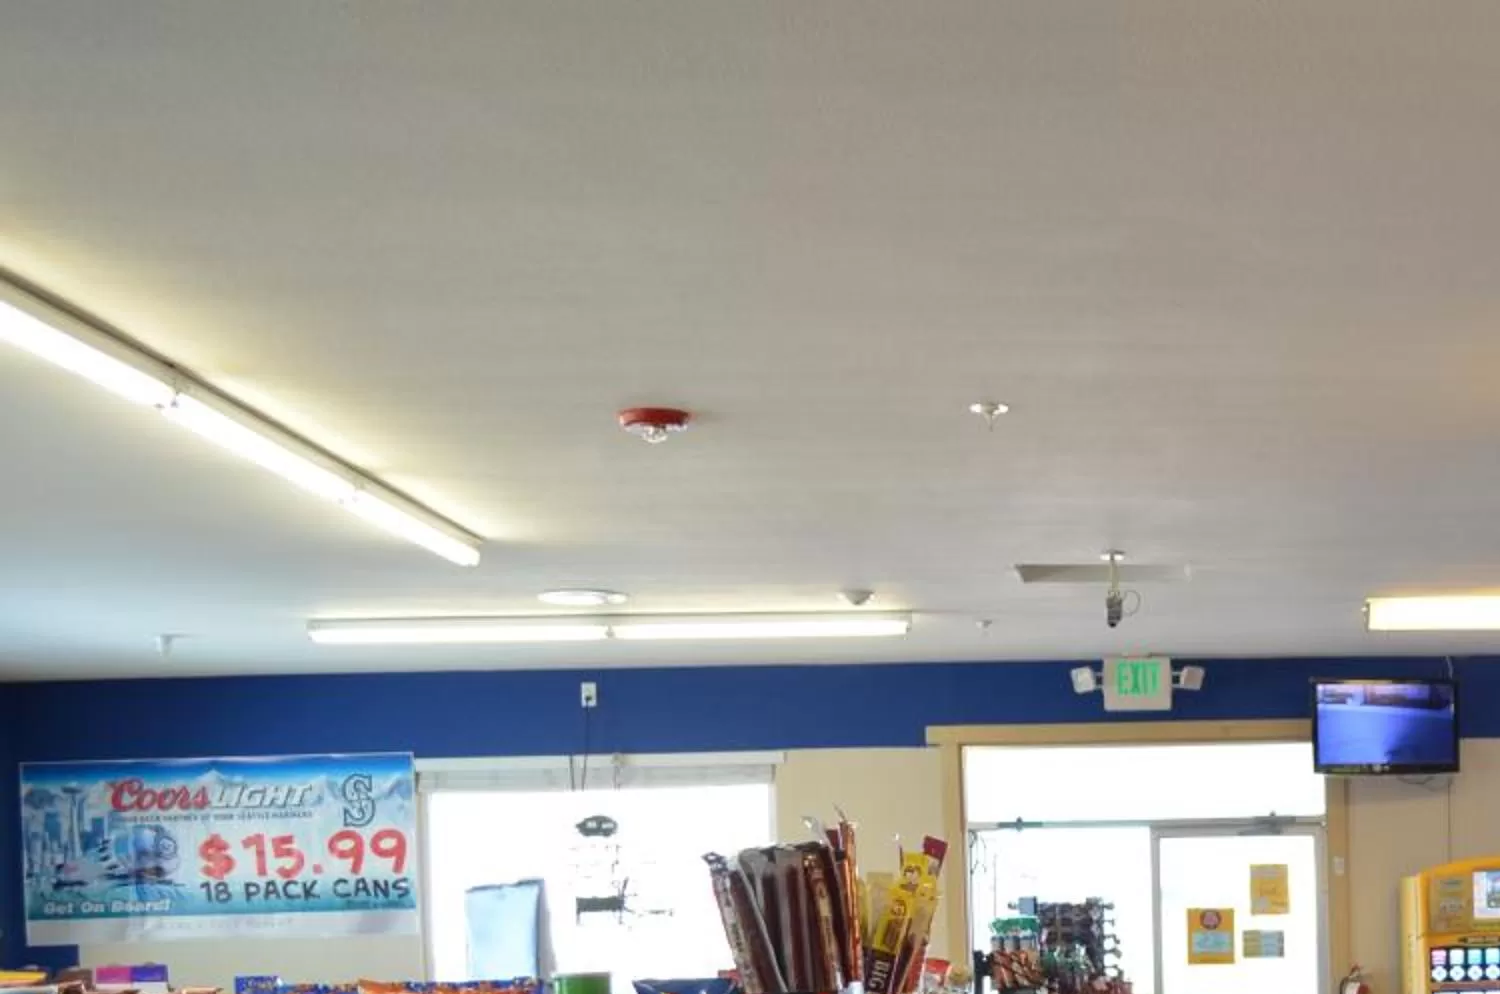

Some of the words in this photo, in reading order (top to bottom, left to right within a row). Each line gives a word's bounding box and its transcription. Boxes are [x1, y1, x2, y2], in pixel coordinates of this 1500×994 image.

[1118, 662, 1161, 695] EXIT
[110, 776, 210, 812] Coors
[209, 782, 313, 809] LIGHT
[199, 828, 408, 880] $15.99
[200, 882, 230, 904] 18
[245, 880, 322, 902] PACK
[333, 877, 412, 899] CANS
